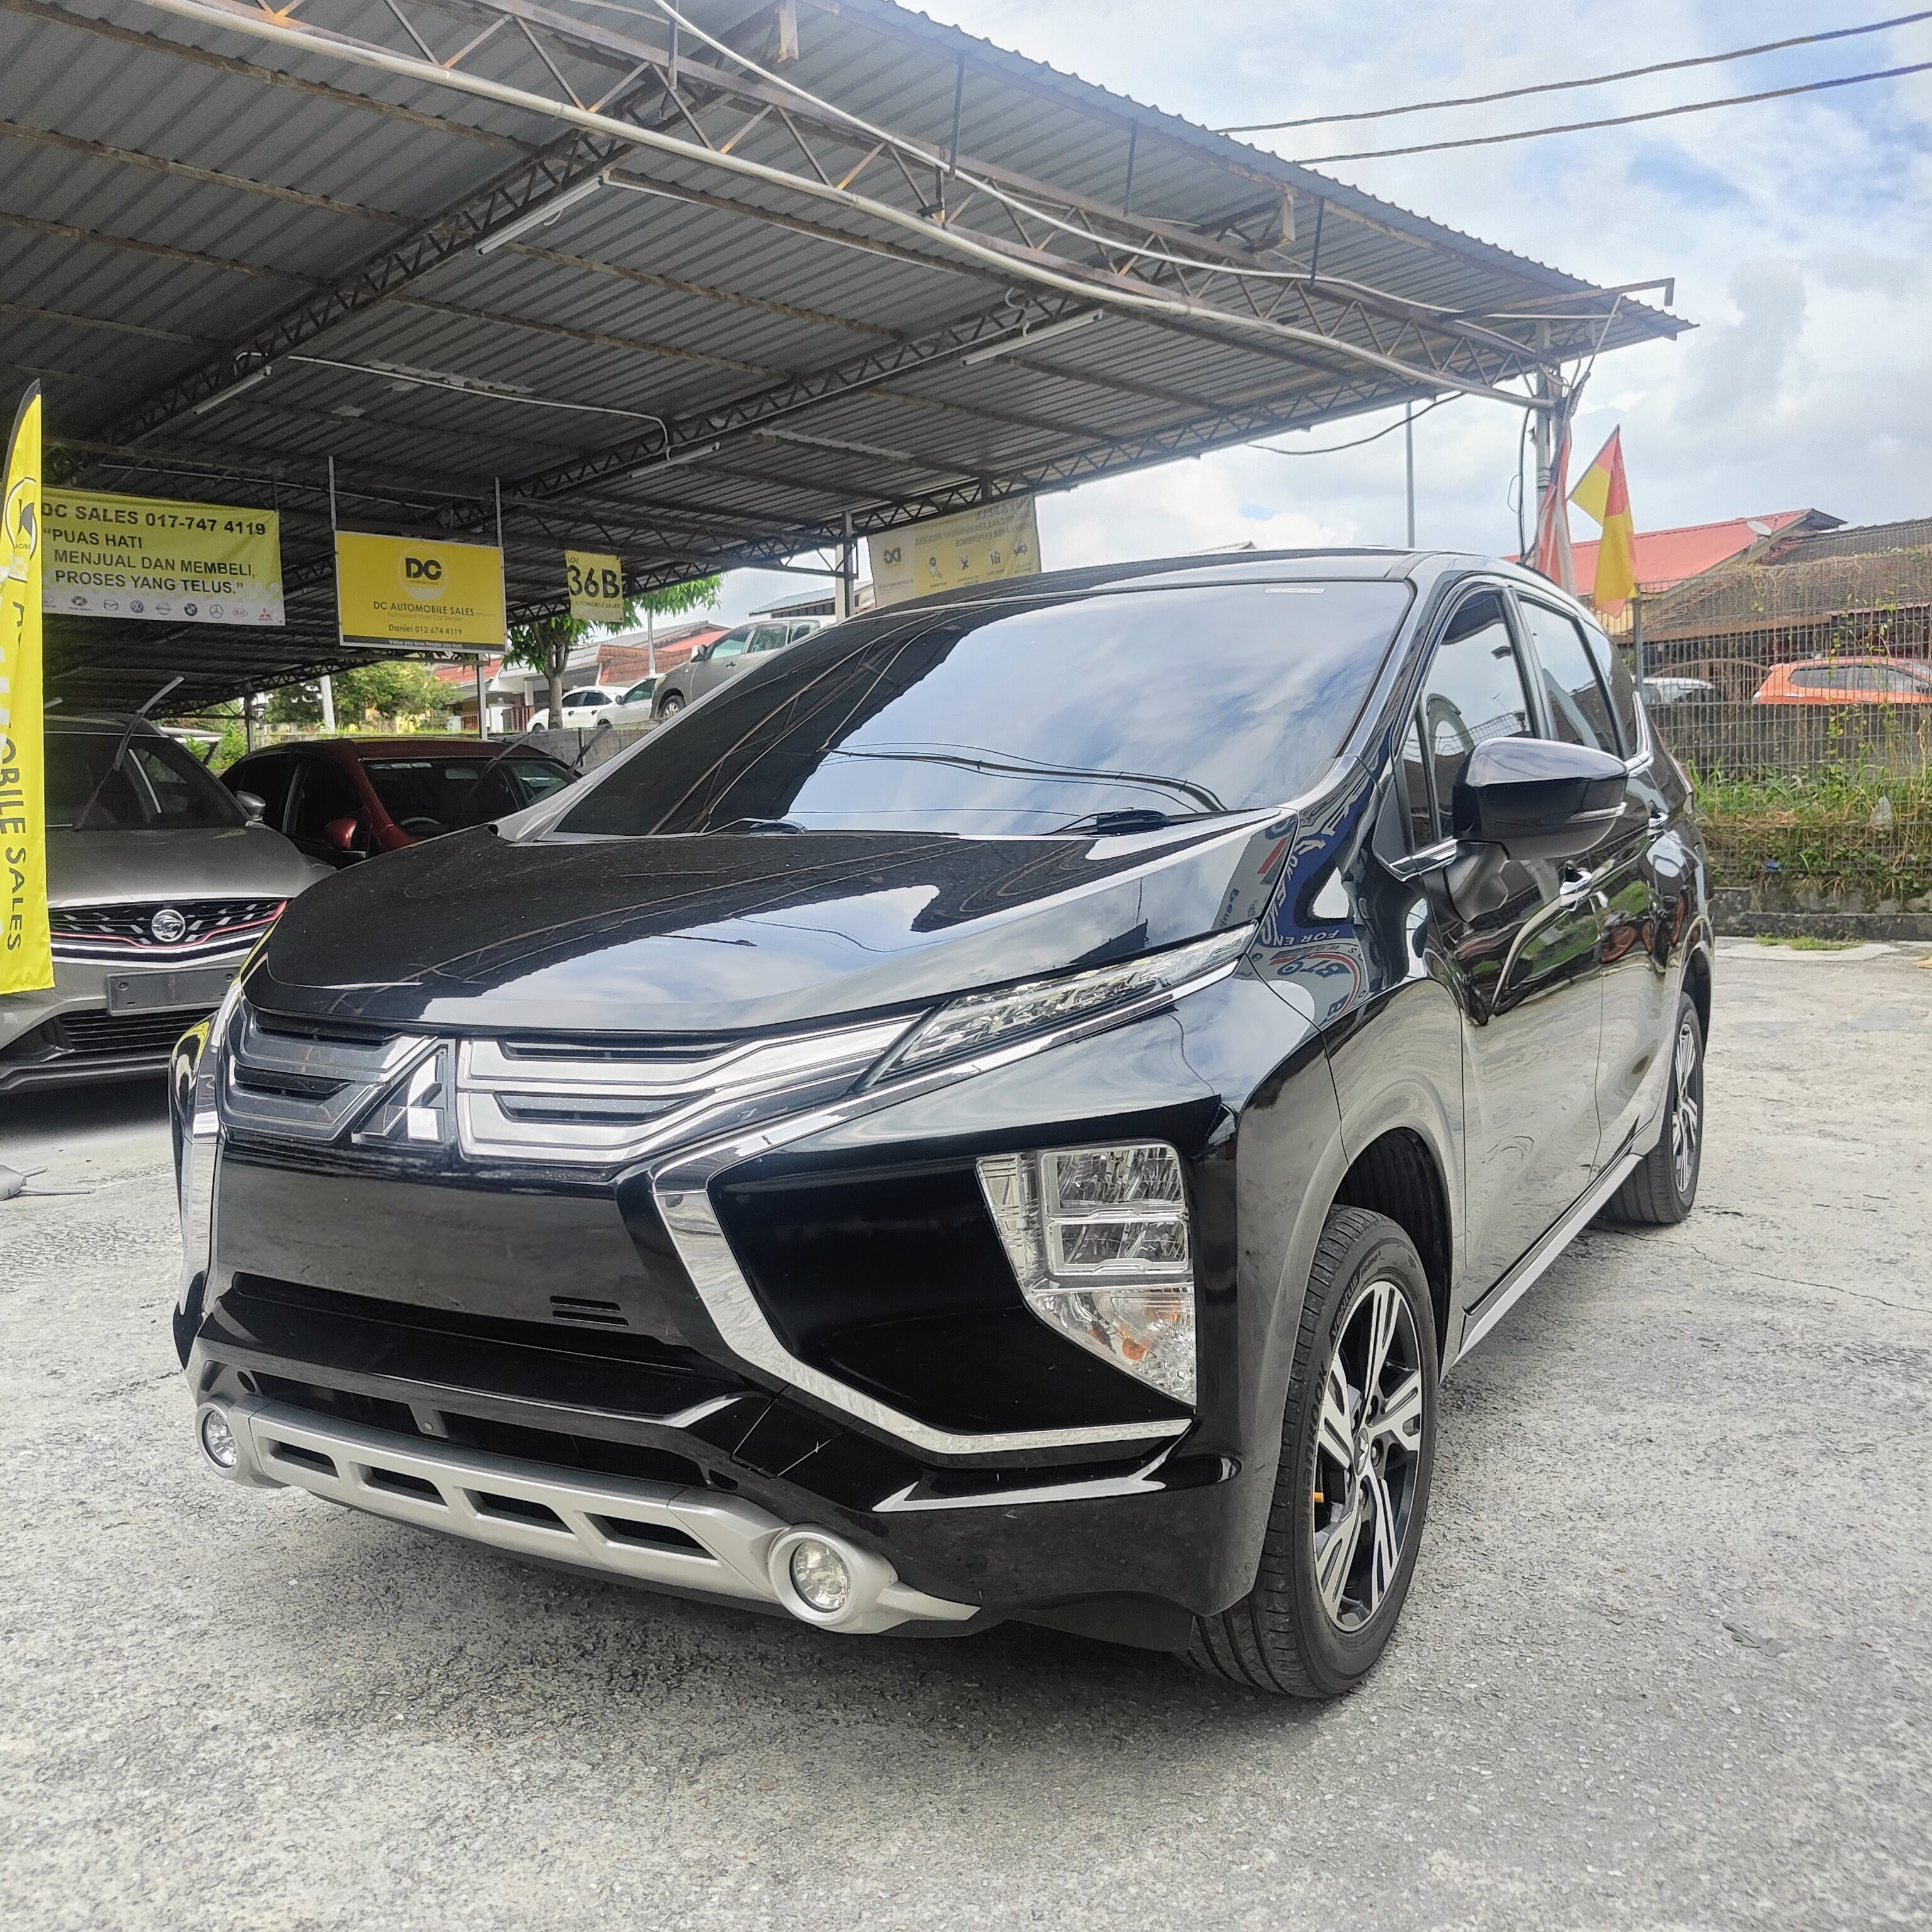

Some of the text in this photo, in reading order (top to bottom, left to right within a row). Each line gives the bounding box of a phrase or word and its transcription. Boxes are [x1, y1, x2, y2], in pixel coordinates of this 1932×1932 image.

[42, 502, 265, 535] DC SALES 017-747 4119
[106, 533, 142, 549] HATI
[54, 550, 255, 579] MENJUAL DAN MEMBELI,
[405, 557, 442, 580] DC
[55, 570, 126, 587] PROSES
[130, 575, 175, 591] YANG
[567, 565, 620, 599] 36B
[374, 601, 387, 610] DC
[391, 602, 447, 614] AUTOMOBILE
[450, 606, 474, 616] SALES
[389, 624, 413, 633] Daniel
[5, 846, 26, 951] SALES
